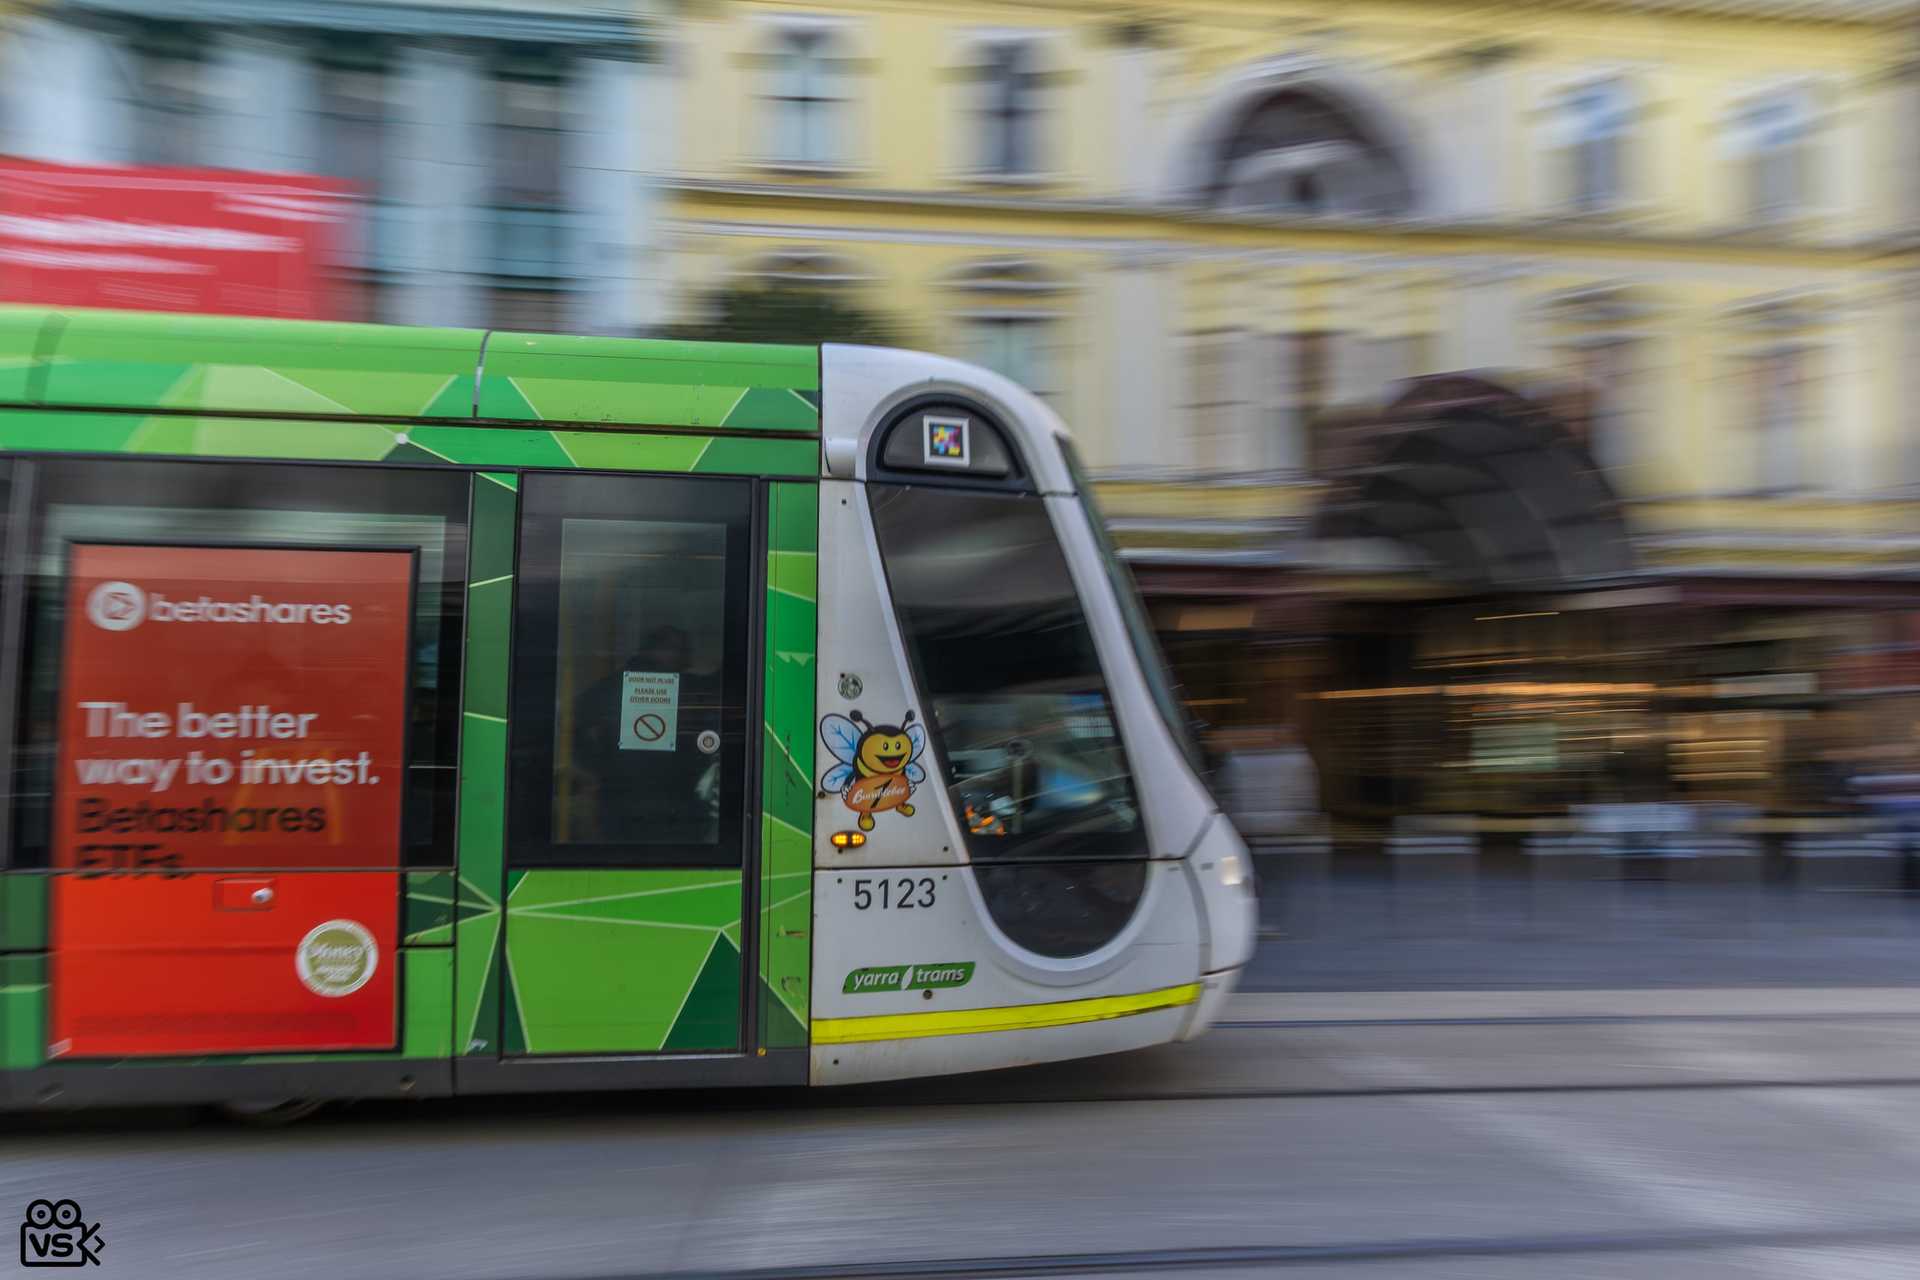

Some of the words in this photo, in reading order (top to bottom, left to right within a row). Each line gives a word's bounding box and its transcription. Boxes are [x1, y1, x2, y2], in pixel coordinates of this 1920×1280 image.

[149, 593, 352, 624] betashares
[77, 701, 171, 738] The
[176, 702, 318, 738] better
[74, 758, 180, 792] way
[186, 751, 233, 785] to
[240, 749, 380, 785] invest.
[76, 796, 327, 834] Betashares
[853, 877, 936, 911] 5123
[854, 973, 899, 991] yarra
[916, 967, 965, 983] trams
